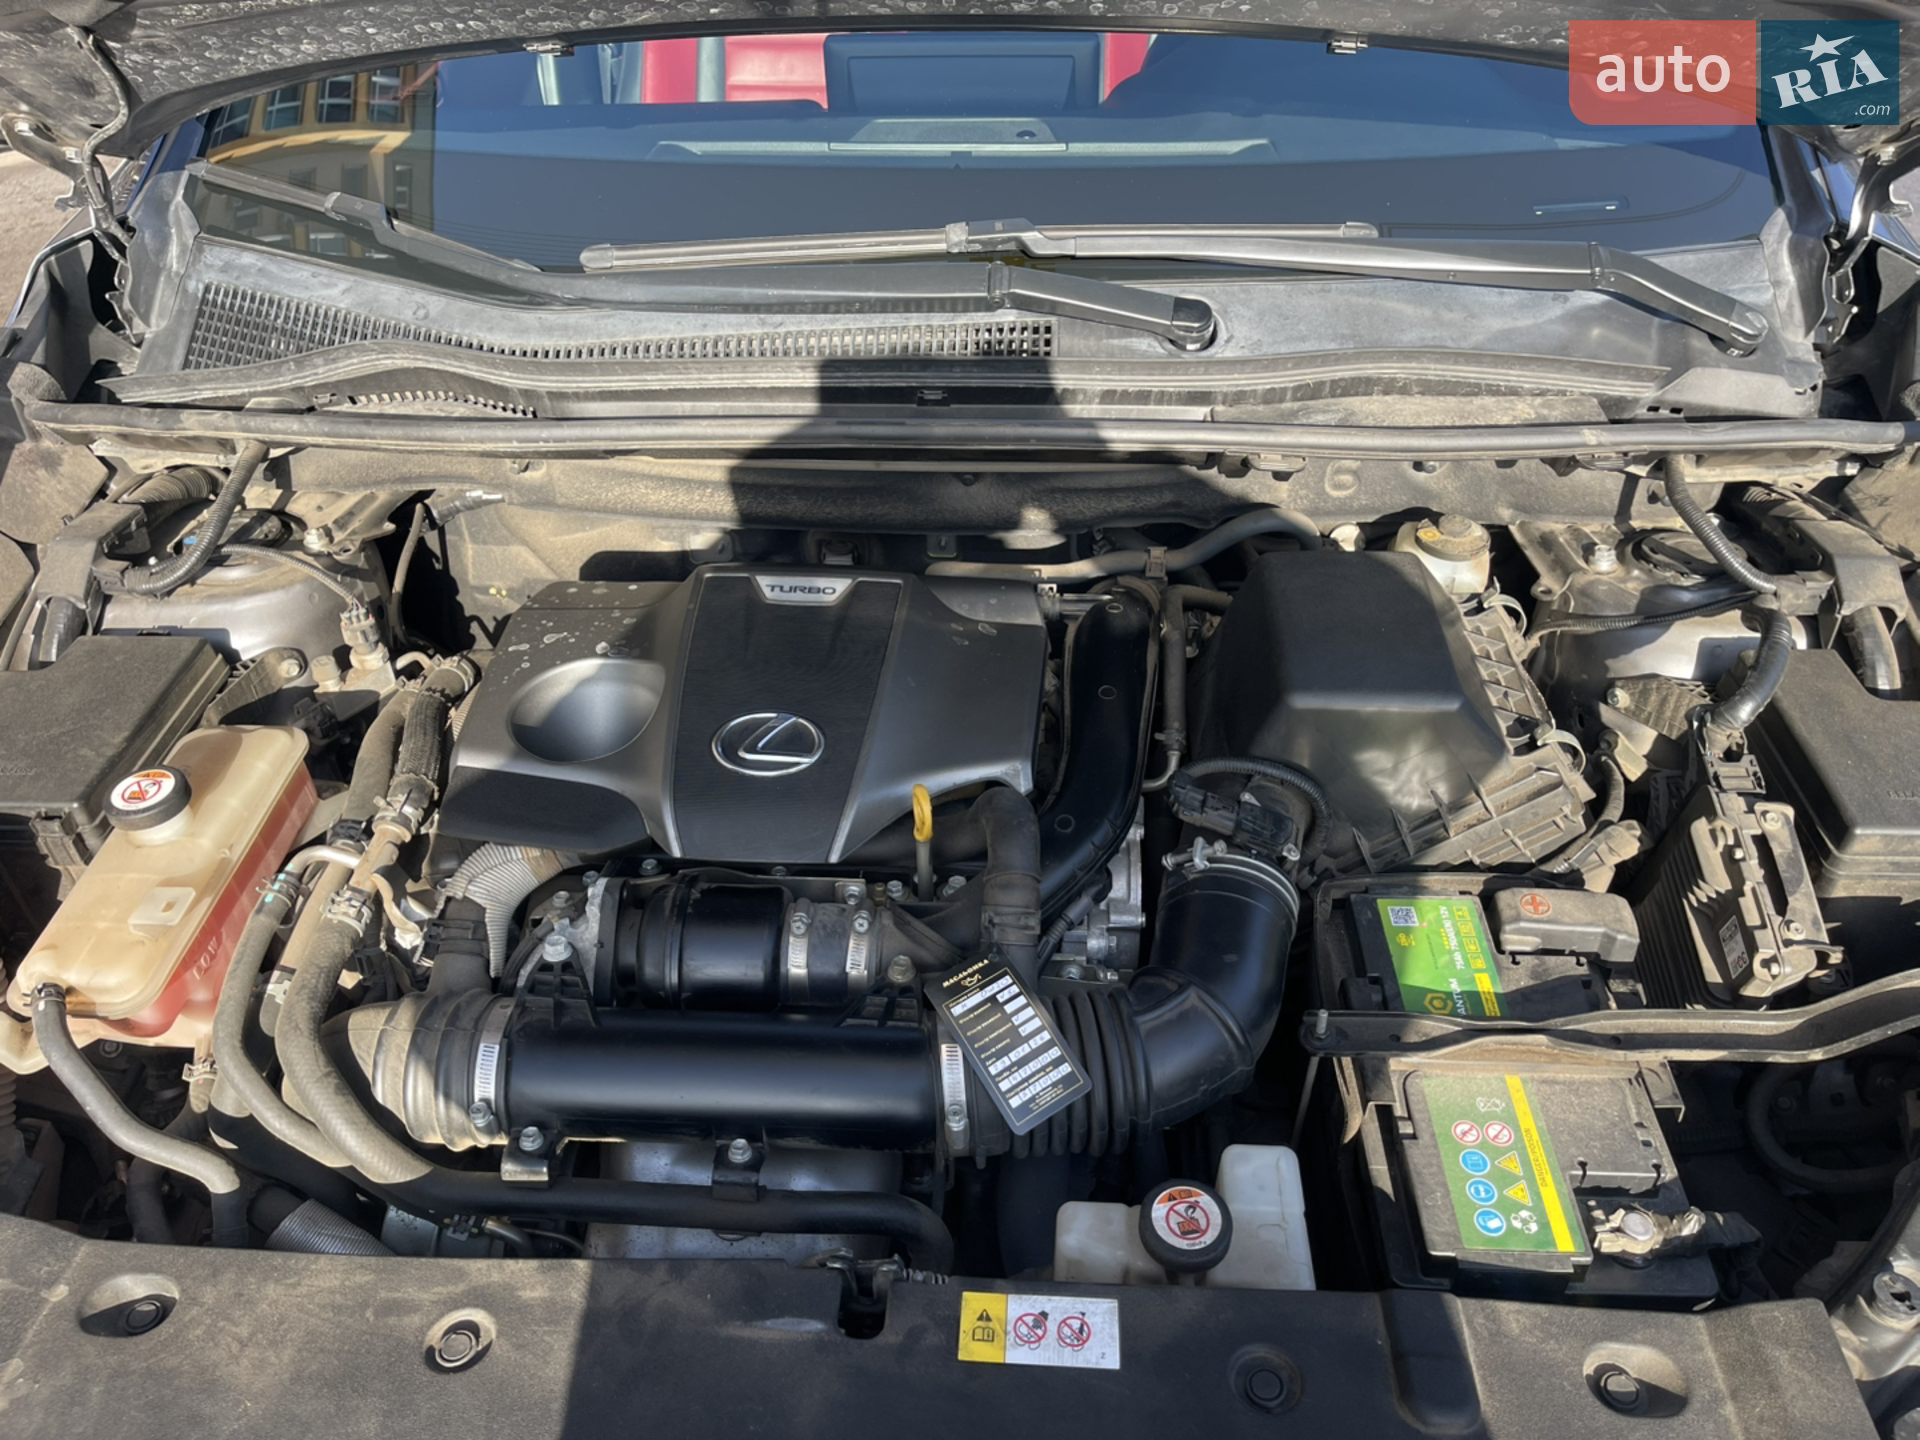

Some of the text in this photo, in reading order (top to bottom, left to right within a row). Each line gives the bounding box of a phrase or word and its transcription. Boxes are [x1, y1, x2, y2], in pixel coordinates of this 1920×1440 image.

[765, 583, 837, 596] TURBO
[192, 935, 218, 981] LOW
[1523, 1127, 1549, 1188] DANGER/POISON
